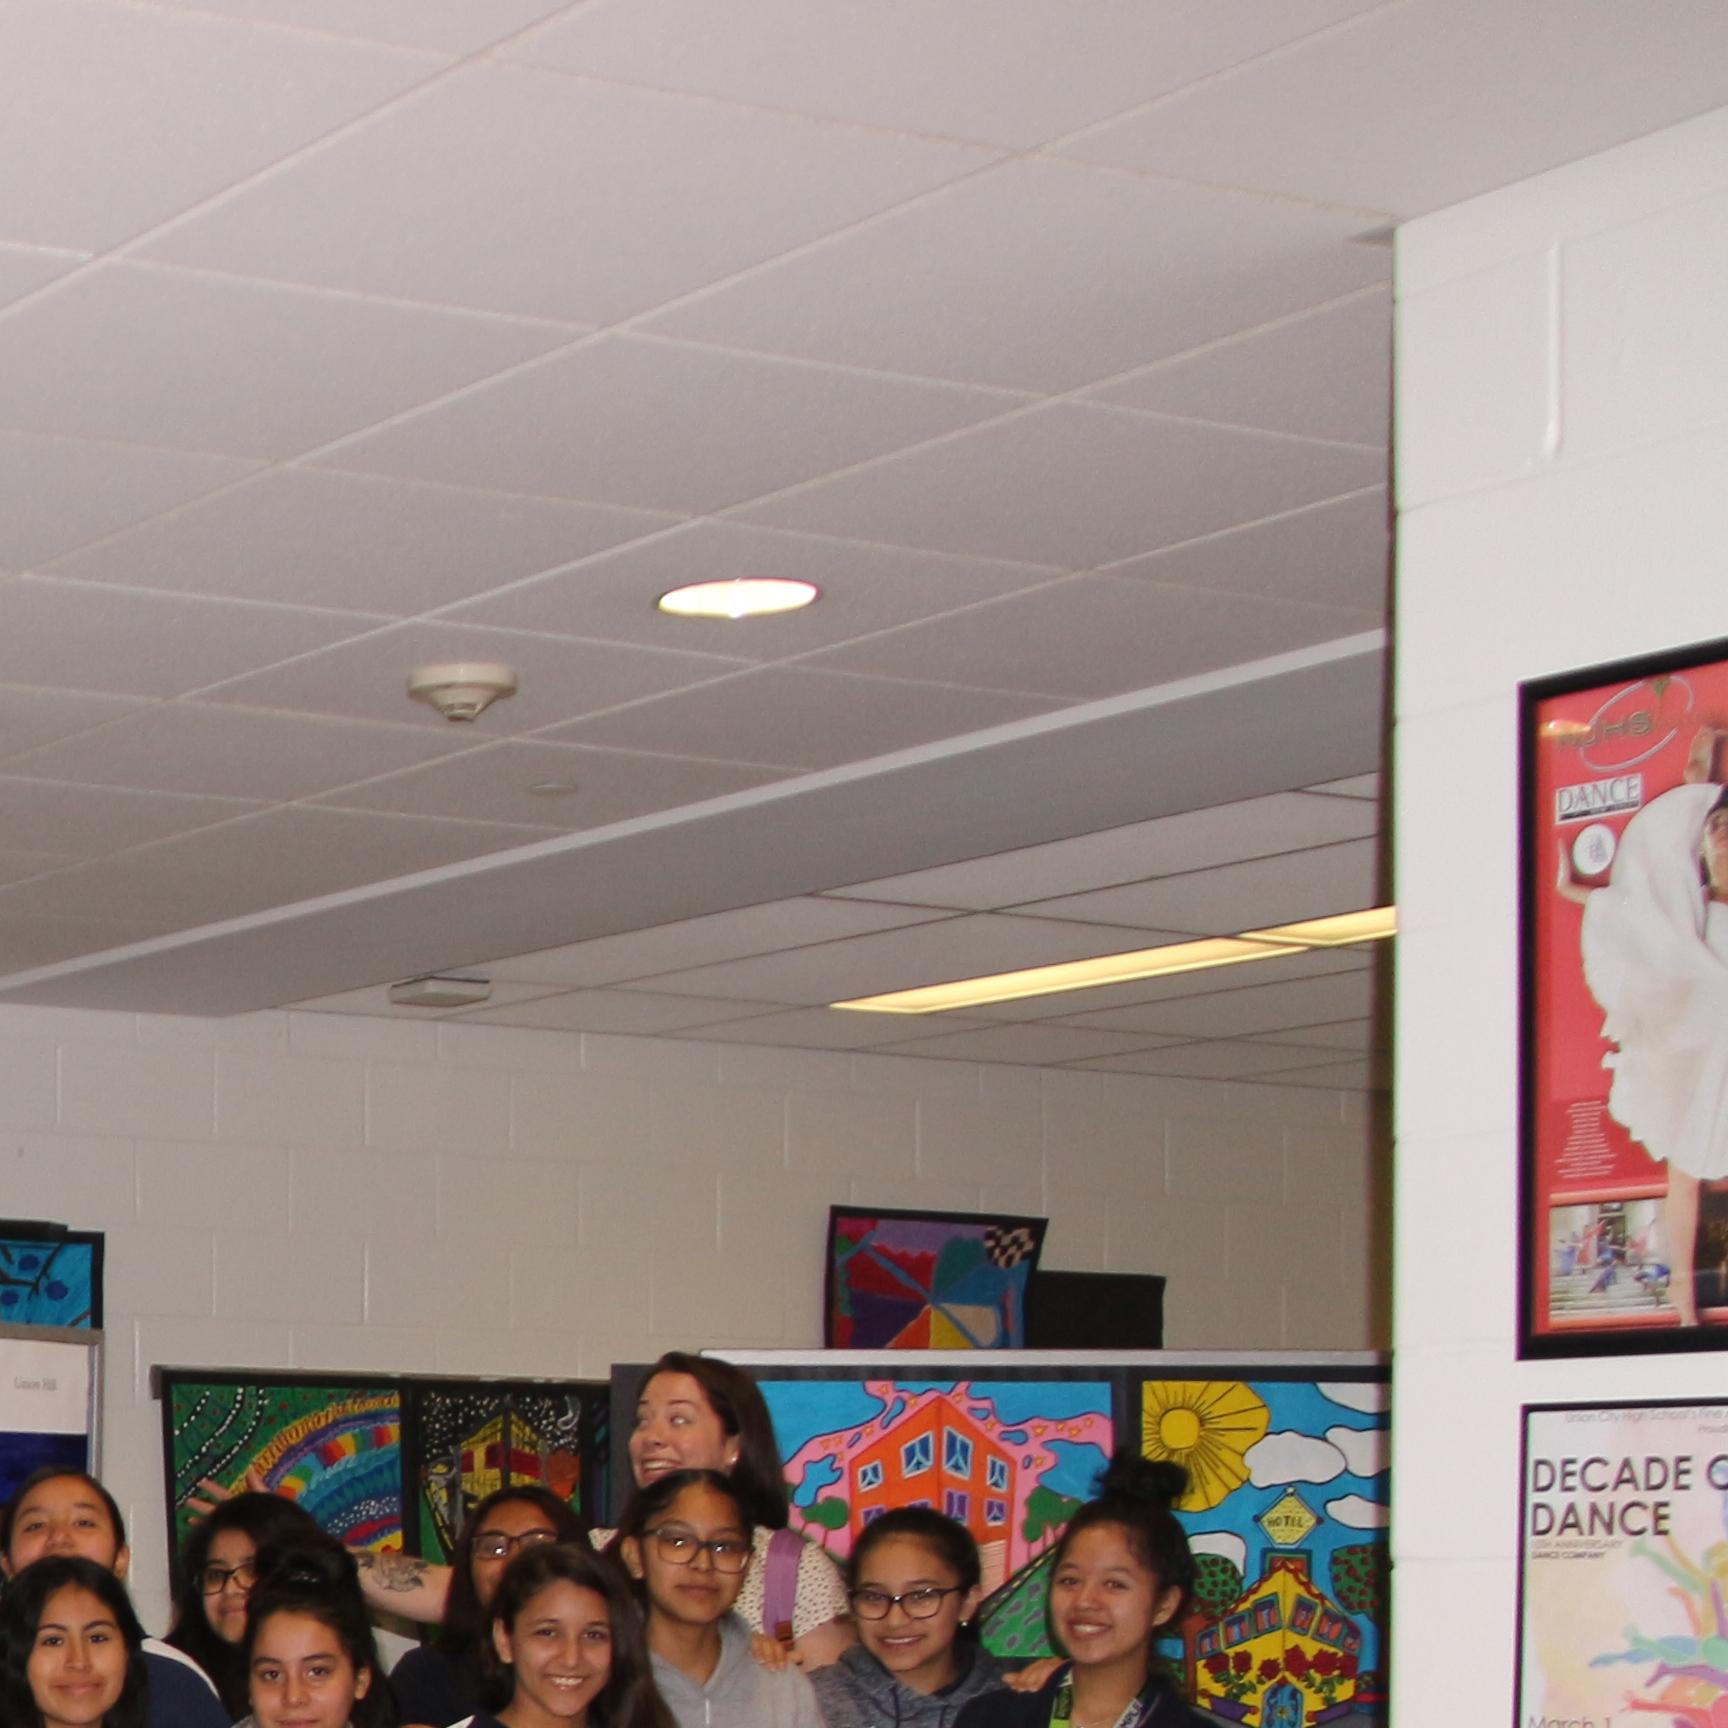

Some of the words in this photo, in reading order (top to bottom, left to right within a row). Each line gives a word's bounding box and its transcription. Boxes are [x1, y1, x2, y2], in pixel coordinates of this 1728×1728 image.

[1558, 776, 1640, 812] DANCE
[1531, 1455, 1693, 1493] DECADE
[1530, 1501, 1671, 1537] DANCE
